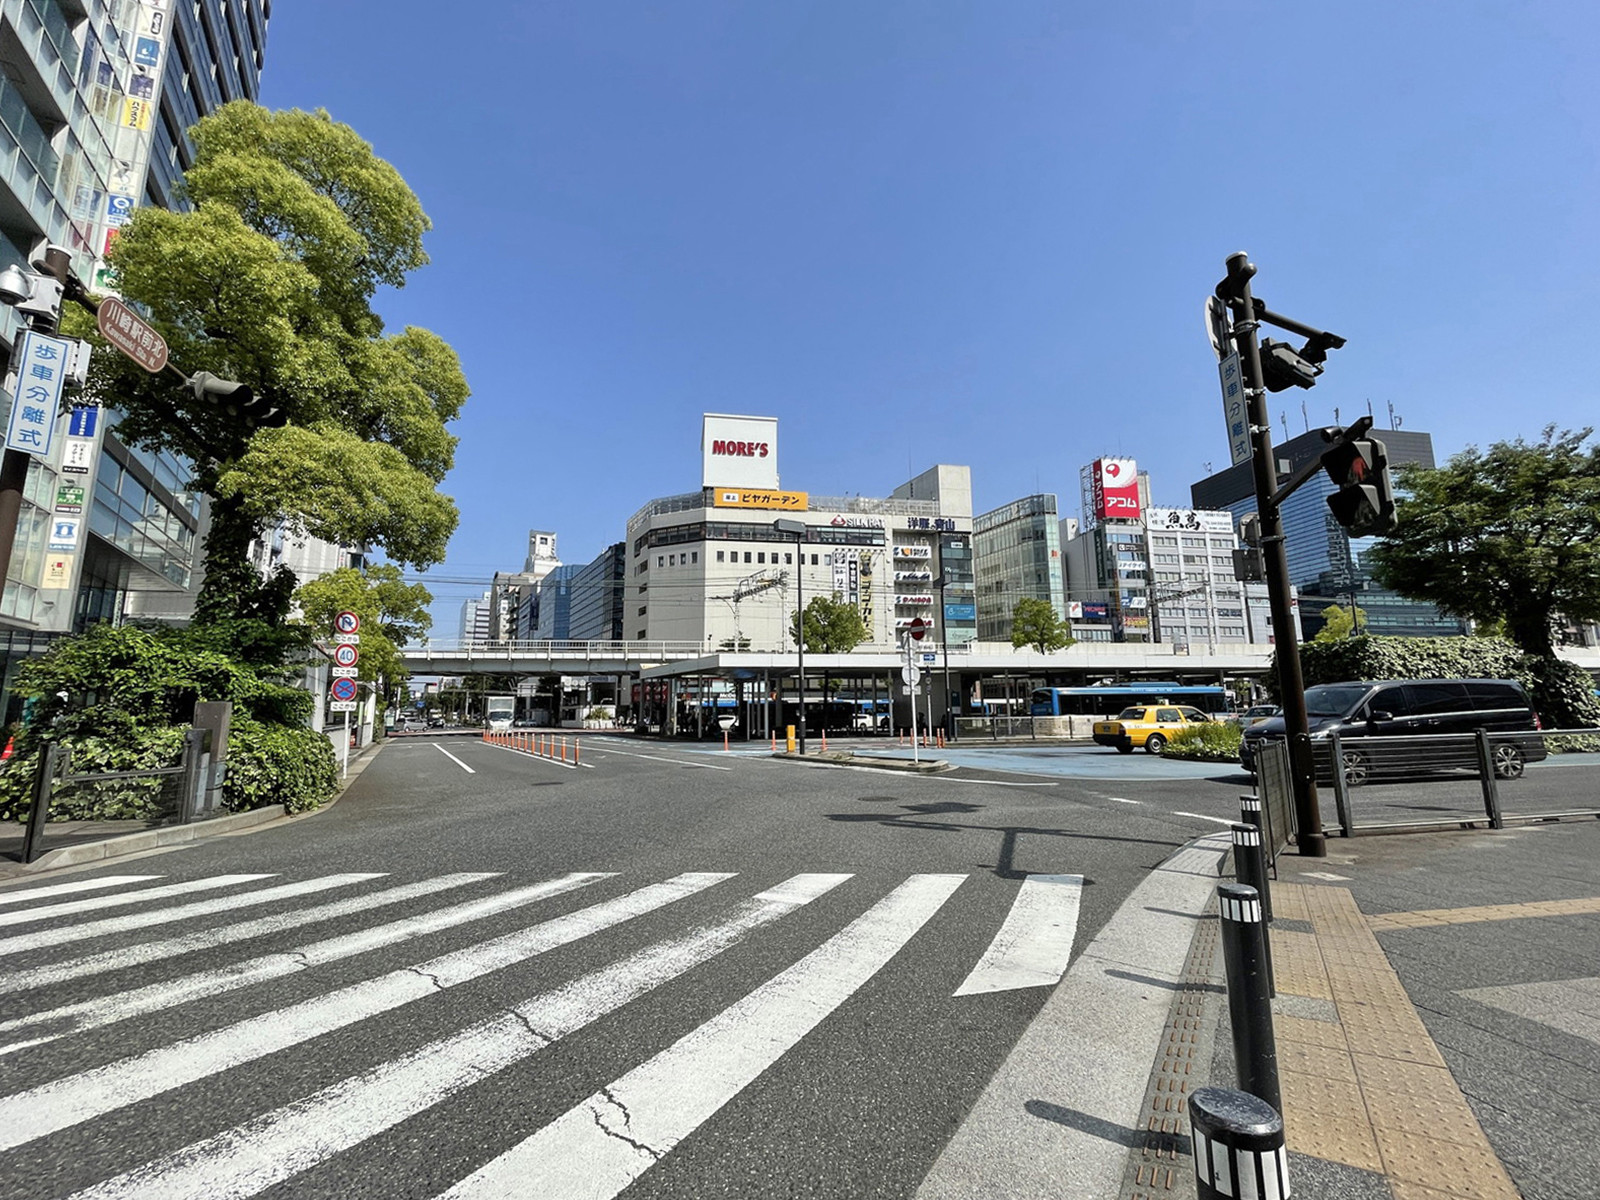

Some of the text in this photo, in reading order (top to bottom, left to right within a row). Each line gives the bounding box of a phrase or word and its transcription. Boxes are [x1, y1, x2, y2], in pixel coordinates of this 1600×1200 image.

[104, 322, 136, 352] Kawasaki
[107, 302, 163, 358] 川崎駅前北
[17, 344, 58, 447] 歩車分離式
[1224, 363, 1248, 458] 歩車分離式
[712, 440, 769, 458] MORE'S
[1095, 481, 1103, 509] アコム
[1107, 497, 1137, 508] アコム
[908, 517, 955, 531] 洋服の青山
[335, 635, 358, 643] ここから
[339, 650, 353, 660] 40
